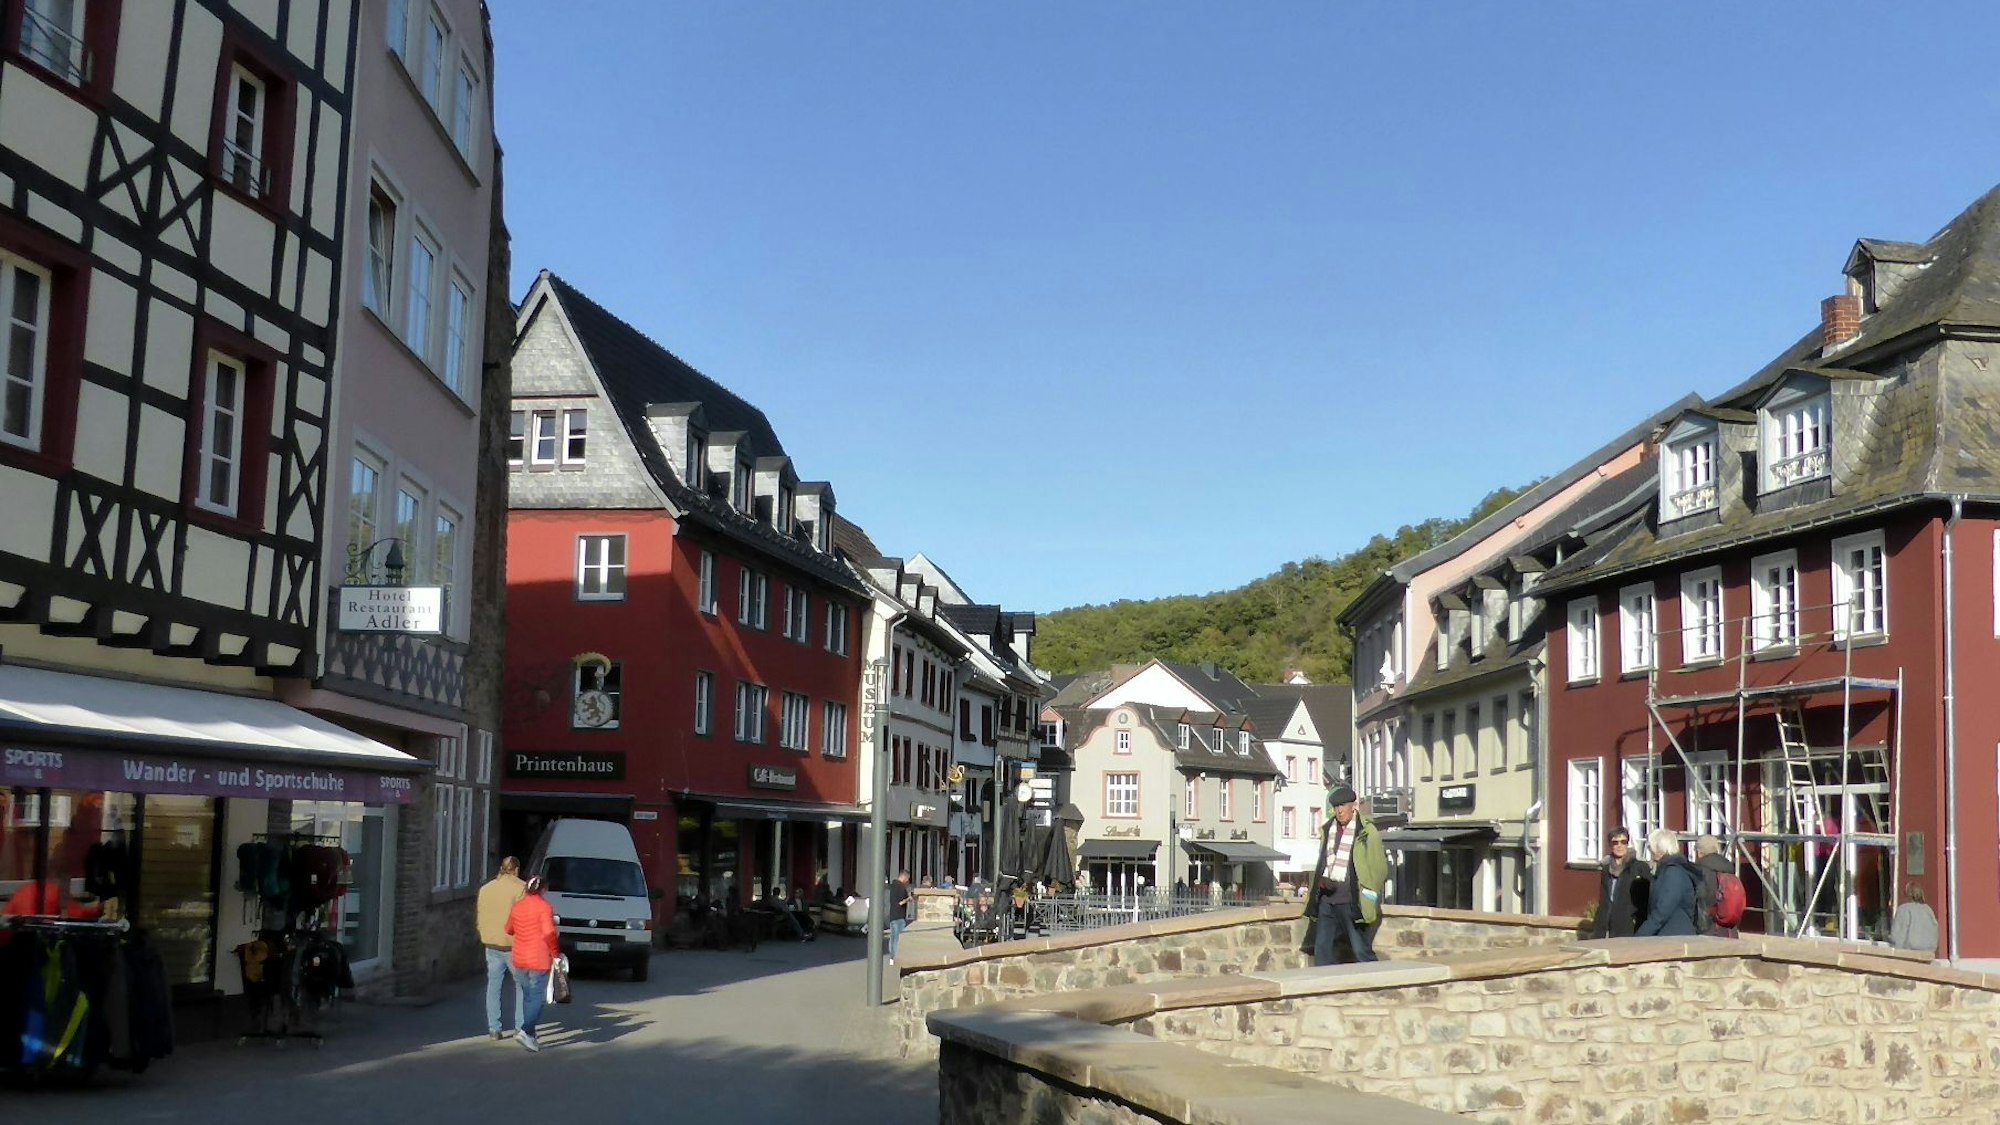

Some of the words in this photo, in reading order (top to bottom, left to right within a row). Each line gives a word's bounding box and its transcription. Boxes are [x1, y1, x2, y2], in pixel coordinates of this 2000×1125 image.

[368, 589, 411, 601] Hotel
[348, 601, 432, 614] Restaurant
[366, 614, 421, 629] Adler
[861, 660, 876, 743] MUSEUM
[5, 748, 63, 769] SPORTS
[515, 754, 614, 773] Printenhaus
[123, 760, 196, 783] Wander
[218, 767, 250, 787] und
[255, 769, 345, 792] Sportschuhe
[380, 776, 411, 790] SPORTS
